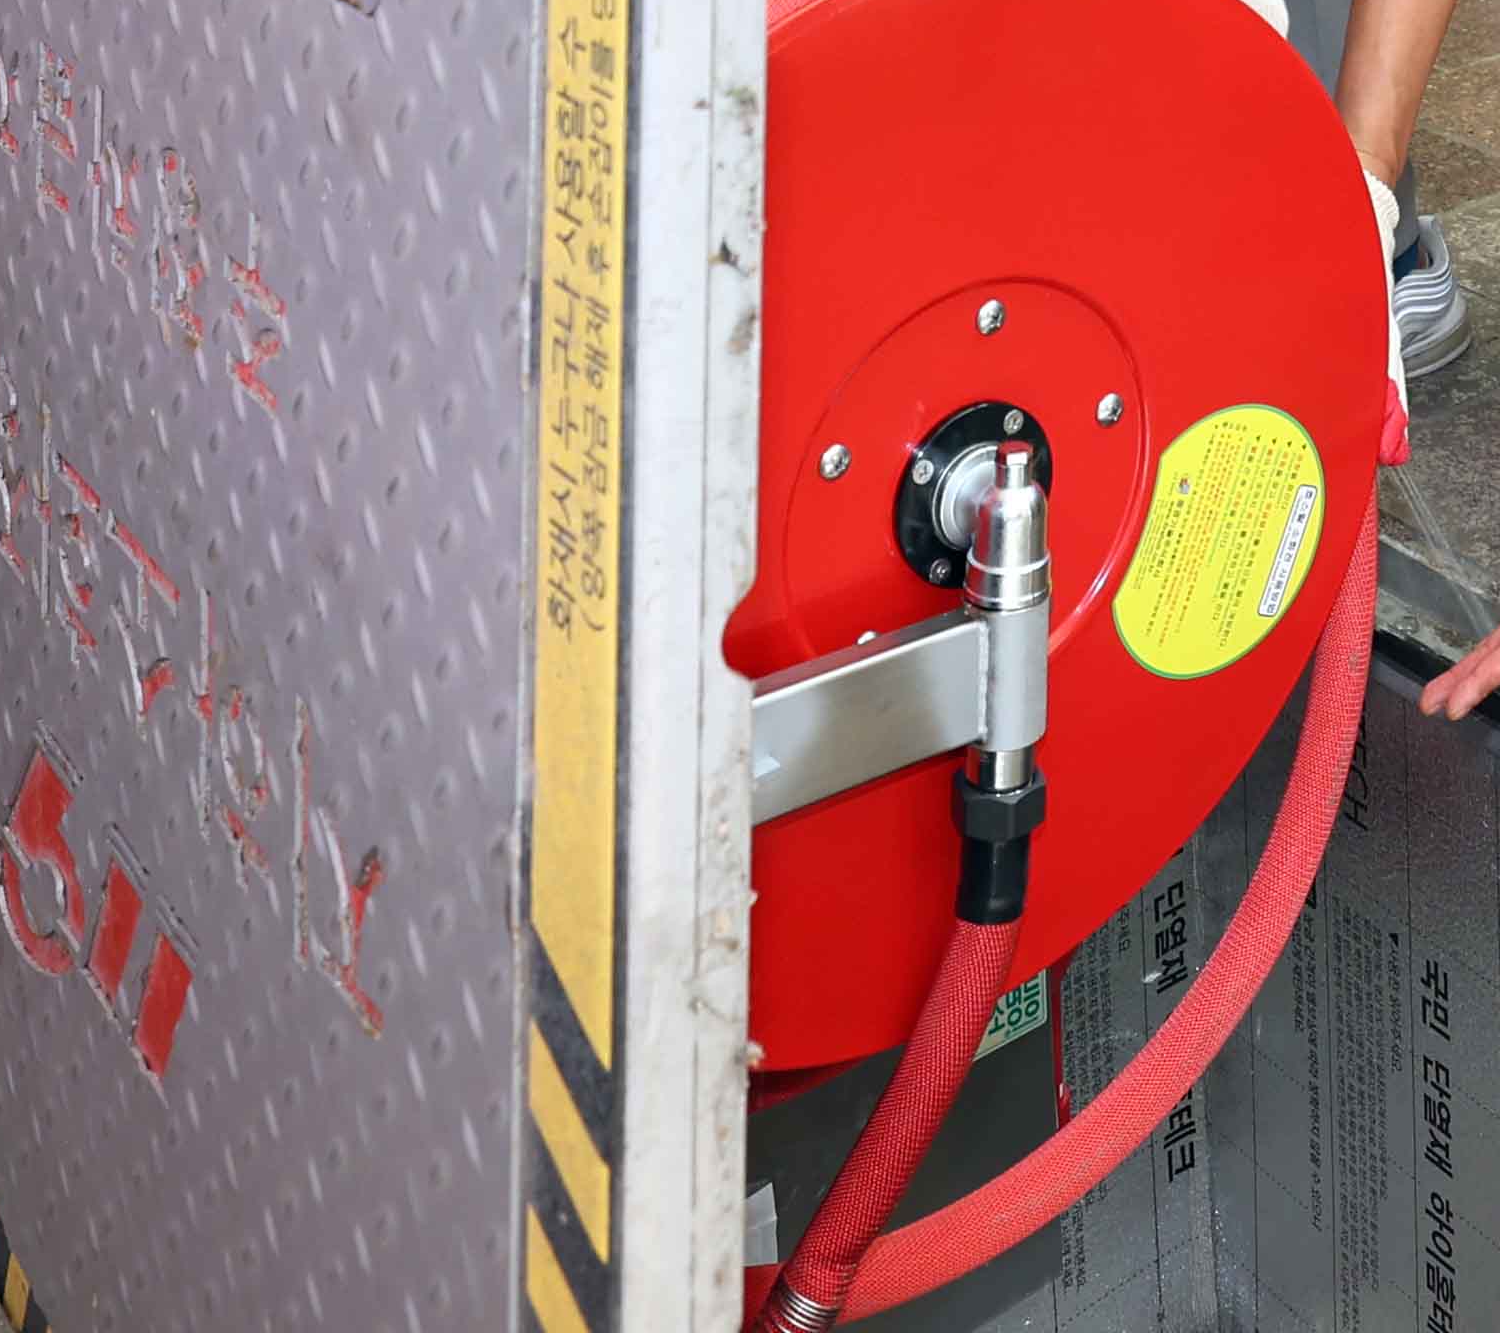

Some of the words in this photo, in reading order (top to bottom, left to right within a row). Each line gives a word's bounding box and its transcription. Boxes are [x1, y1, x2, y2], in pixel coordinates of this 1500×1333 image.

[557, 18, 588, 70] 수
[551, 88, 588, 265] 사용할
[548, 277, 581, 452] 누구나
[1155, 882, 1189, 994] 단열재
[1420, 958, 1454, 1038] 국민
[1420, 1057, 1455, 1179] 단열재
